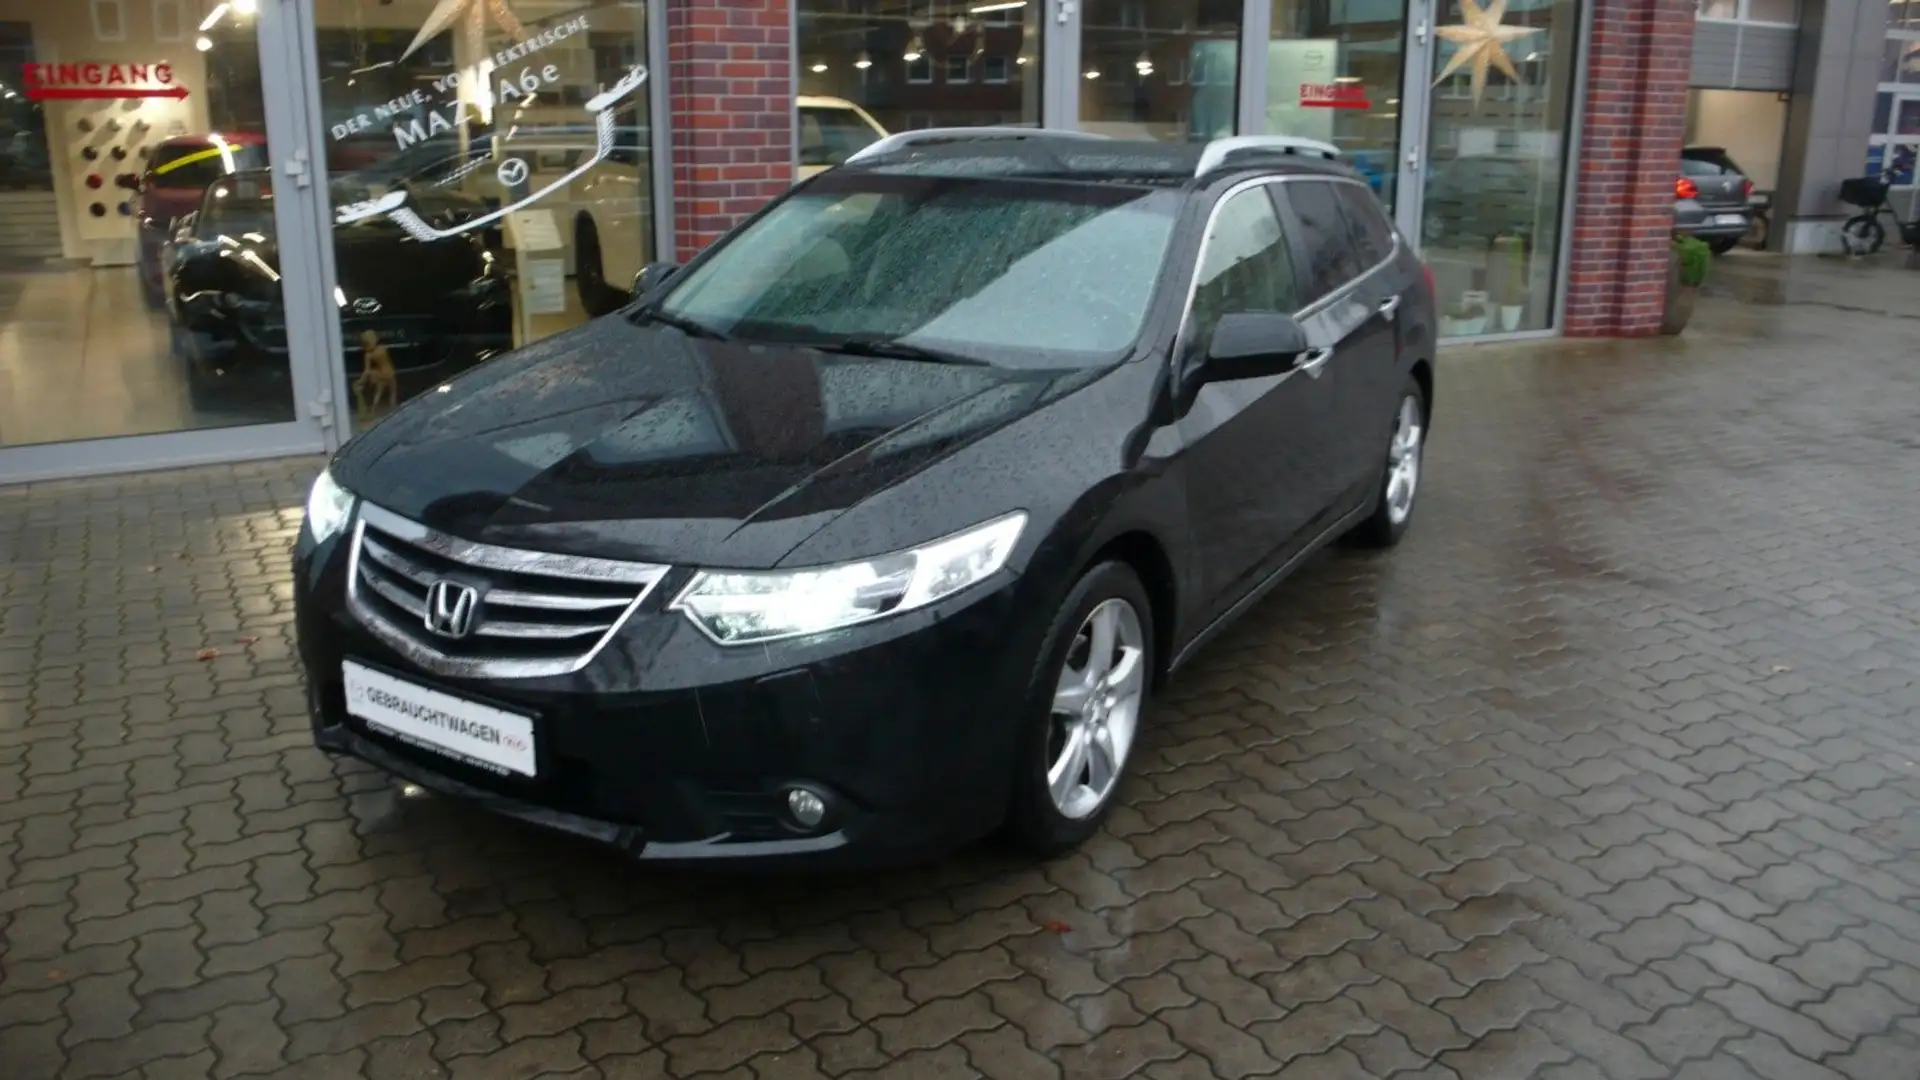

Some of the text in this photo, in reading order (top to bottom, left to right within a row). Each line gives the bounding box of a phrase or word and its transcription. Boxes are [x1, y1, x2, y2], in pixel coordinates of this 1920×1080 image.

[22, 63, 173, 85] EINGANG
[331, 113, 373, 141] DER
[432, 15, 591, 94] VOEKTRISCHE
[392, 64, 561, 151] MAZA6e
[366, 686, 501, 746] GEBRAUCHTWAGEN
